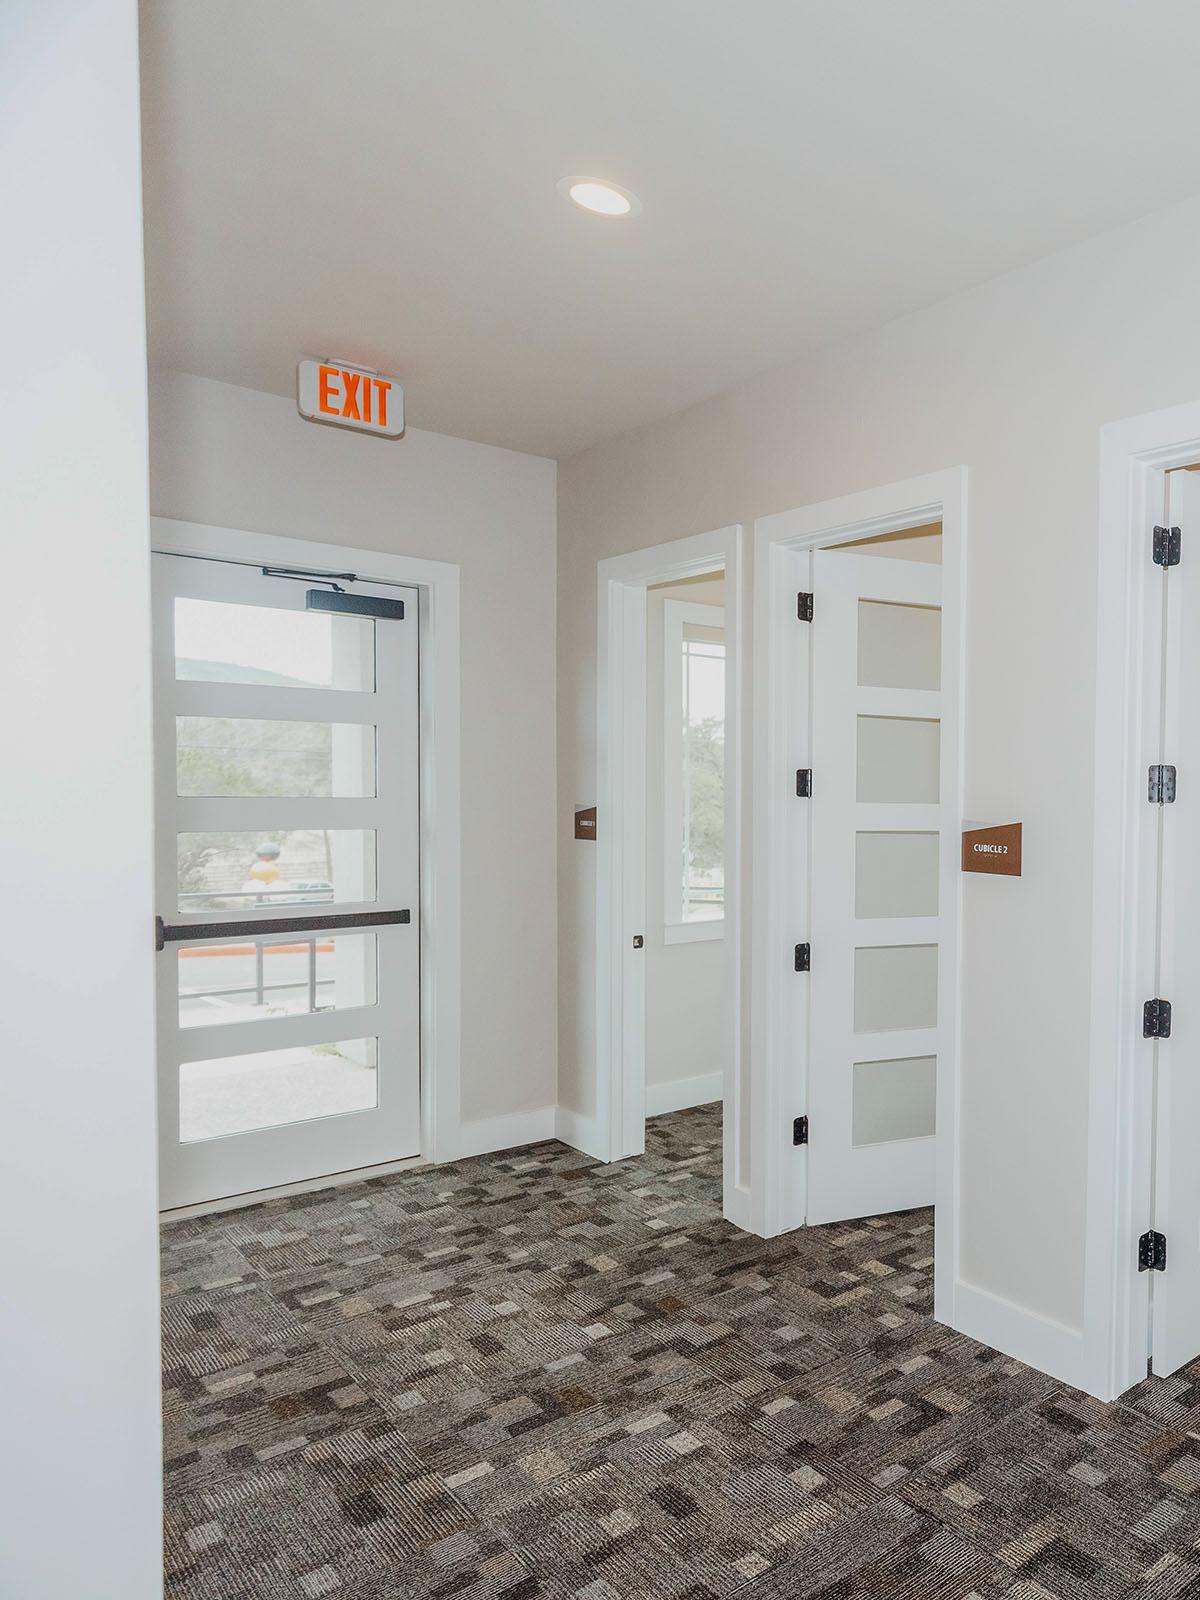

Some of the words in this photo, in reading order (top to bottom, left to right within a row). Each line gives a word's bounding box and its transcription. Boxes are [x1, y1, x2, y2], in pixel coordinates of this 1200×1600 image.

[318, 364, 392, 427] EXIT
[973, 843, 1002, 854] CUBICLE
[1003, 845, 1008, 854] 2
